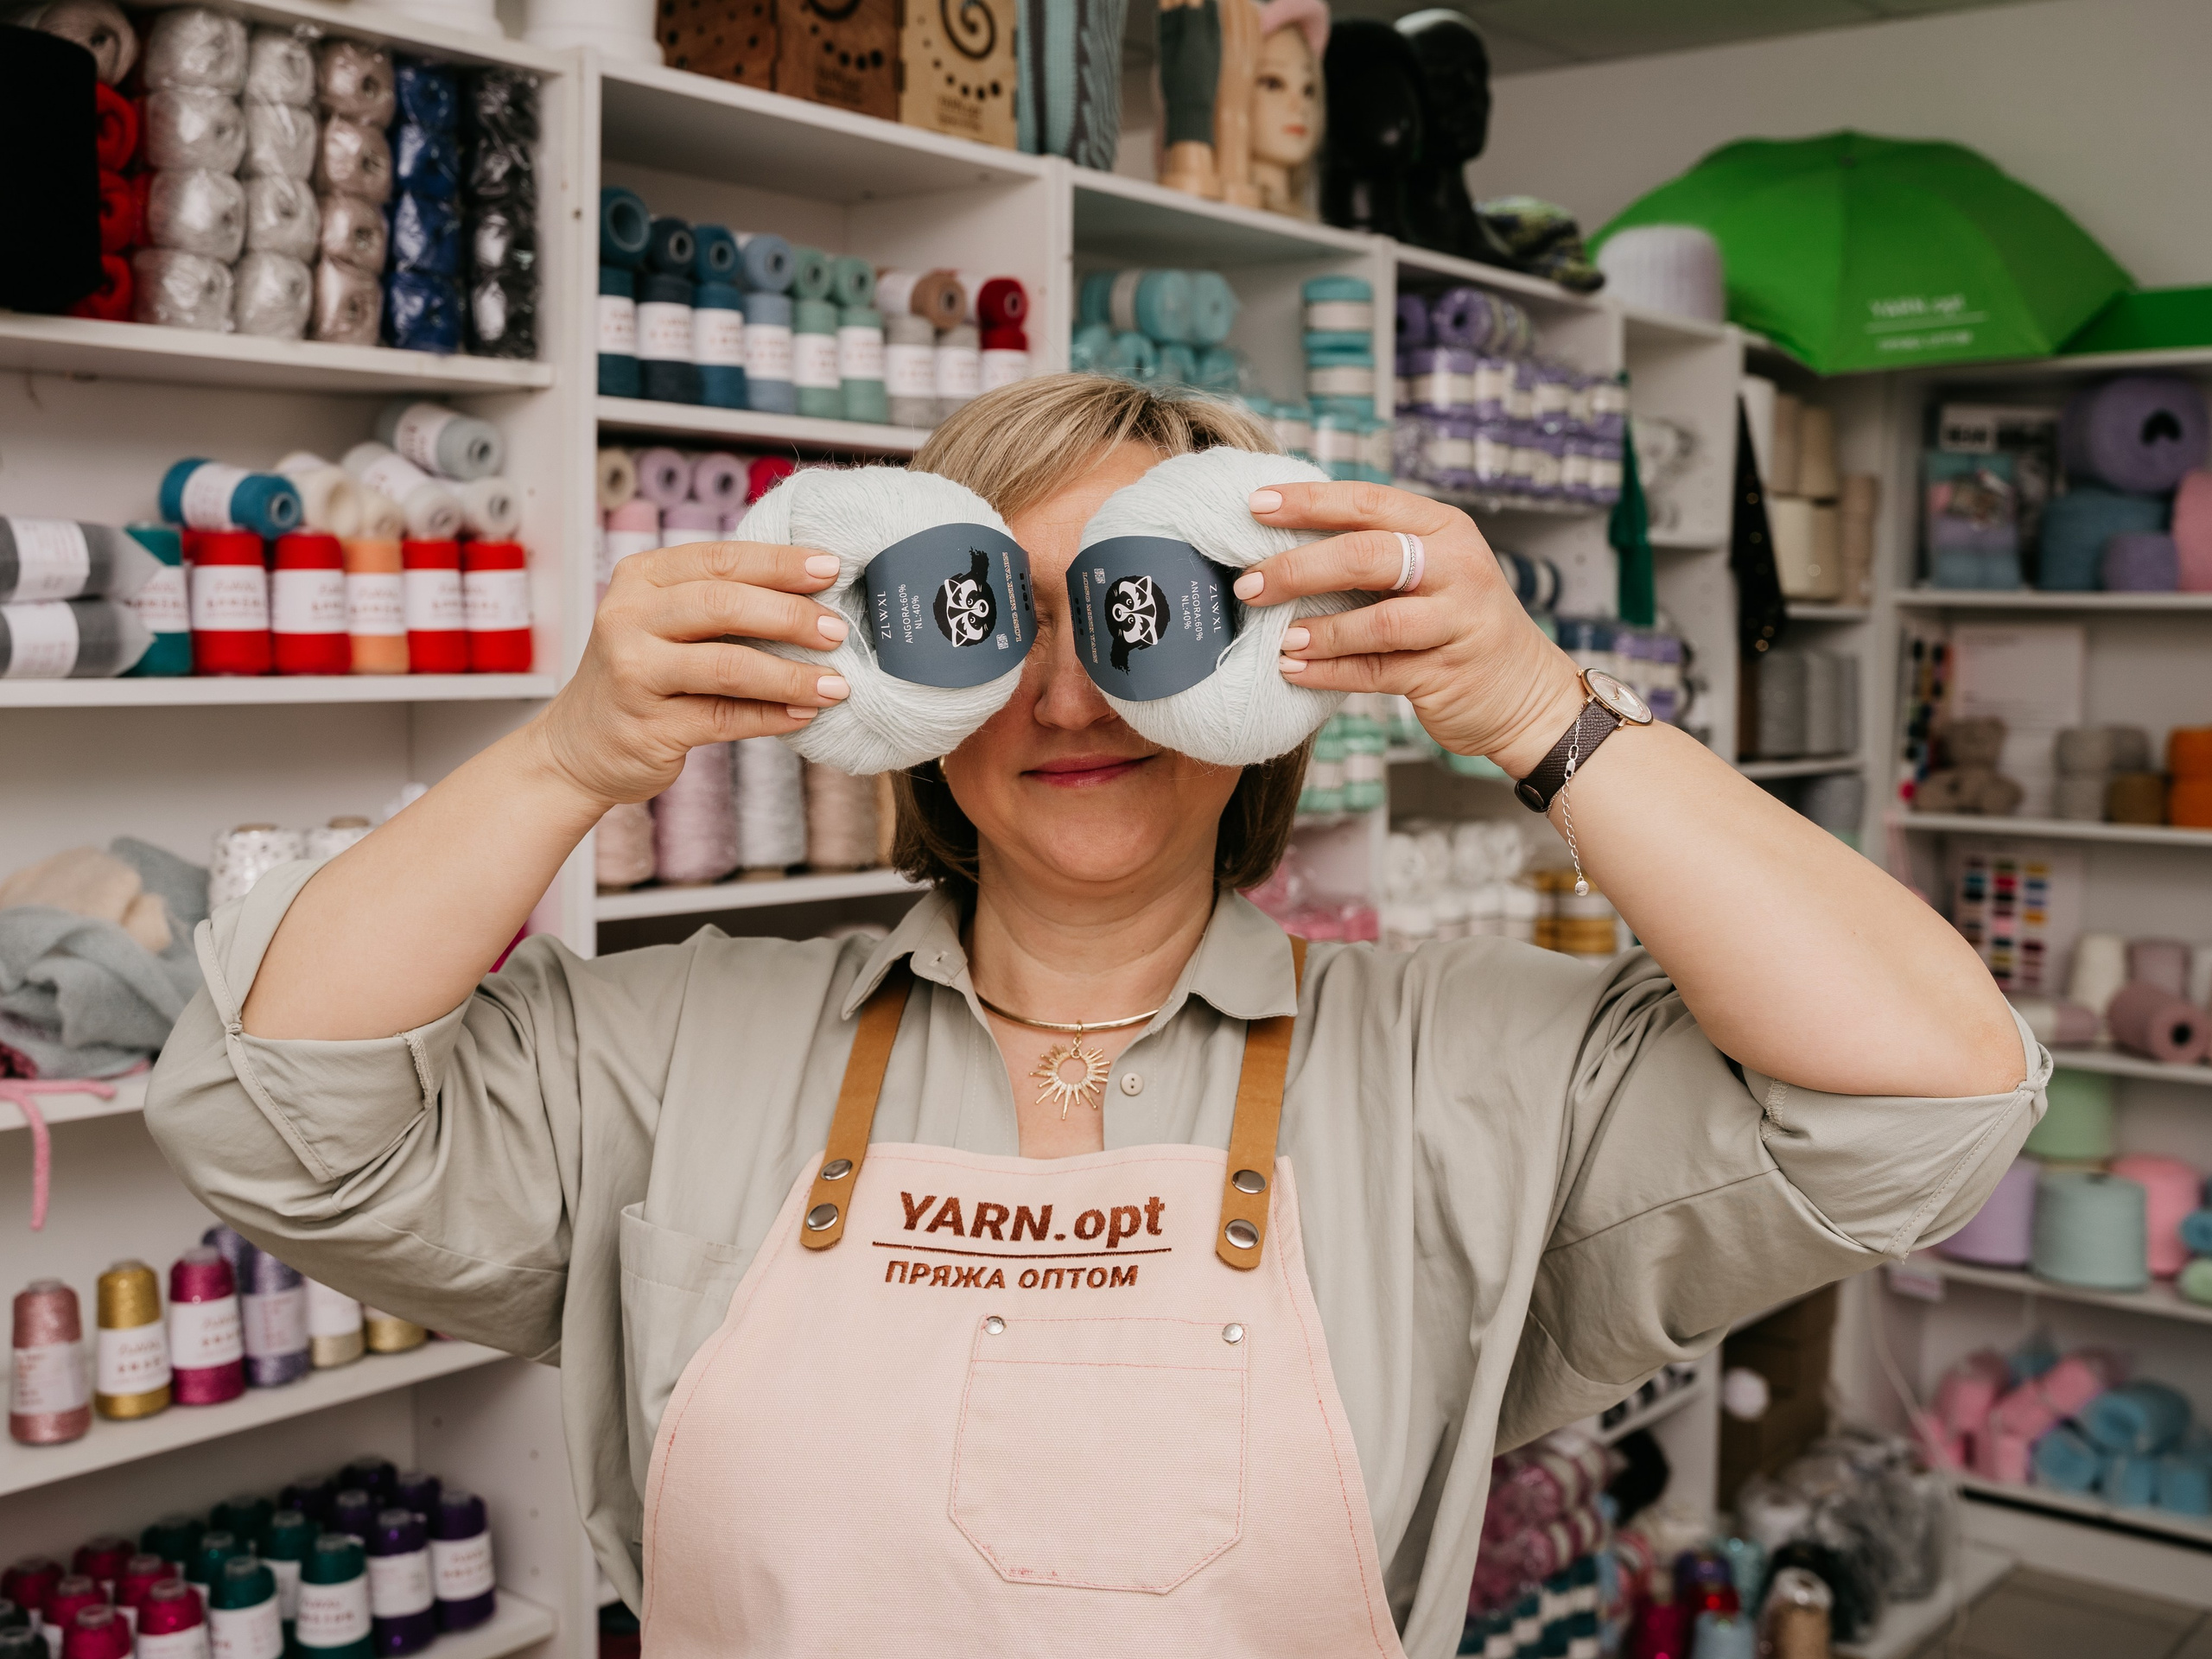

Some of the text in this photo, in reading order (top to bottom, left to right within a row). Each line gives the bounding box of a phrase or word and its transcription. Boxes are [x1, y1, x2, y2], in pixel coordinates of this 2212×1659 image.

[877, 590, 892, 640] ZLWXL
[898, 583, 913, 644] ANGORA:60%
[912, 594, 923, 630] NL:40%
[1181, 594, 1192, 630] NL:40%
[1190, 580, 1204, 641] ANGORA:60%
[1209, 583, 1222, 633] ZLWXL
[899, 1191, 1166, 1249] YARN.opt
[885, 1260, 1139, 1290] ПРЯЖА ОПТОМ
